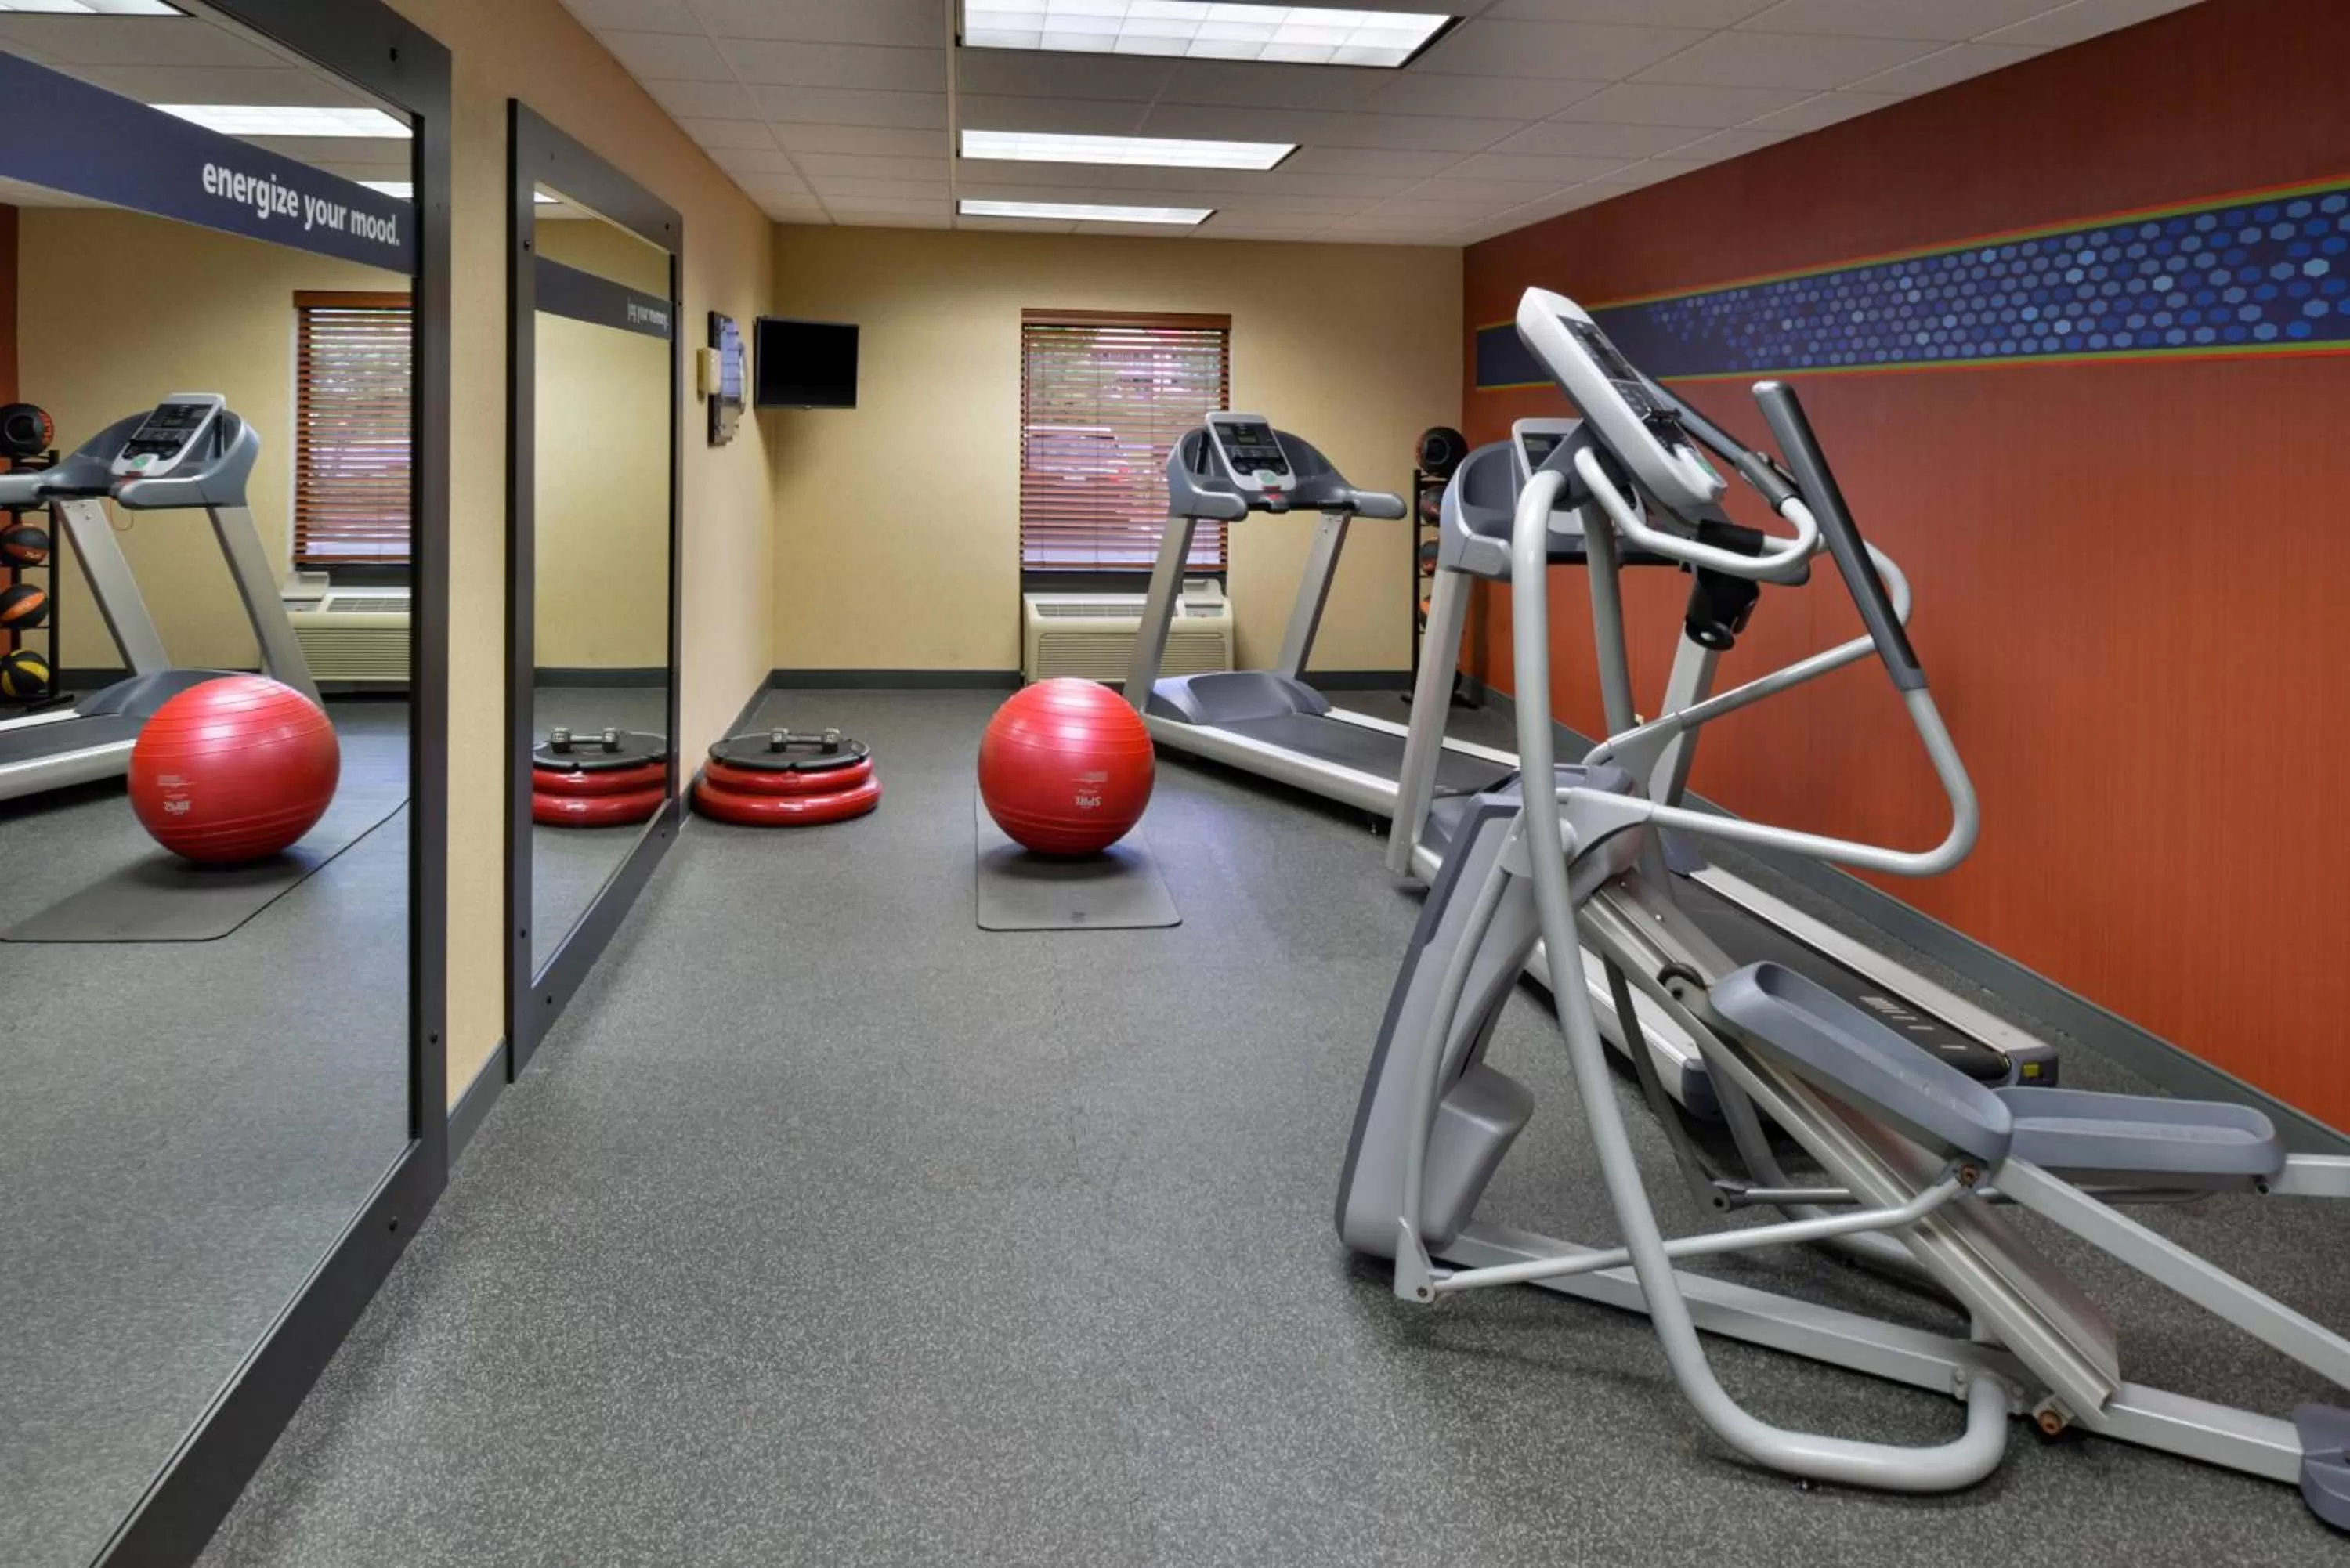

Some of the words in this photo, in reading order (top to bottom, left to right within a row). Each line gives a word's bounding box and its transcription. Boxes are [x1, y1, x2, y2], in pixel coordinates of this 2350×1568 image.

[202, 163, 298, 219] energize
[304, 194, 346, 230] your
[351, 207, 400, 246] mood.
